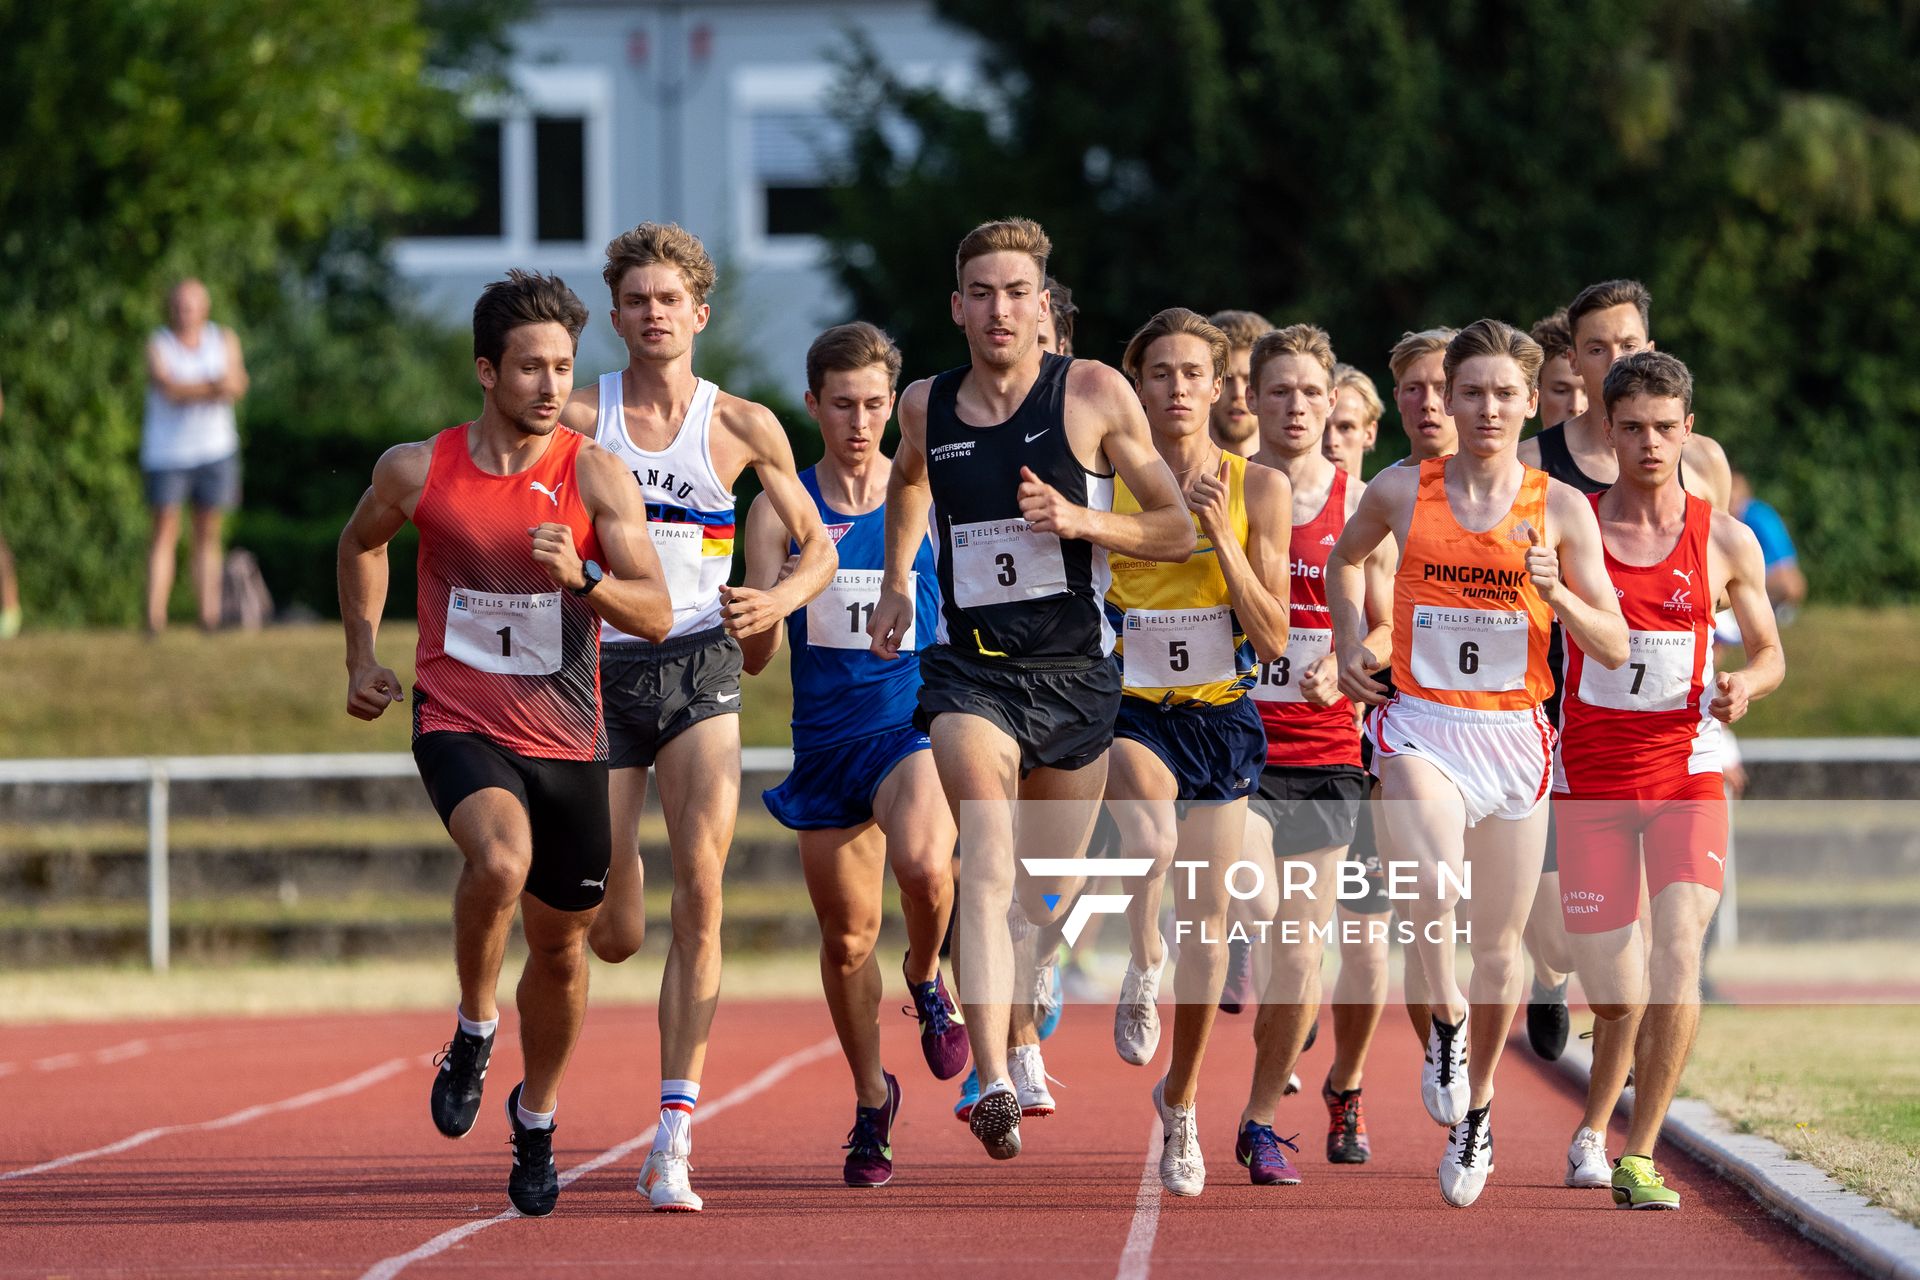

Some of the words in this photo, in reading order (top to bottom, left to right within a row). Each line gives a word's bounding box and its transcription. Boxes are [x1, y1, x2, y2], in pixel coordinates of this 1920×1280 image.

[935, 449, 971, 461] BLESSING
[654, 529, 695, 539] FINANZ
[971, 527, 1000, 538] TELIS
[1005, 523, 1032, 534] FINA
[995, 553, 1018, 586] 3
[1424, 563, 1527, 587] PINGPANK
[471, 597, 504, 608] TELIS
[1462, 586, 1519, 604] running
[846, 602, 876, 633] 11
[1144, 616, 1176, 624] TELIS
[1437, 613, 1470, 623] TELIS
[496, 626, 511, 657] 1
[1168, 641, 1189, 672] 5
[1458, 641, 1479, 674] 6
[1258, 656, 1291, 686] 13
[1629, 663, 1646, 695] 7
[1569, 891, 1605, 903] NORD
[1567, 904, 1599, 914] BERLIN
